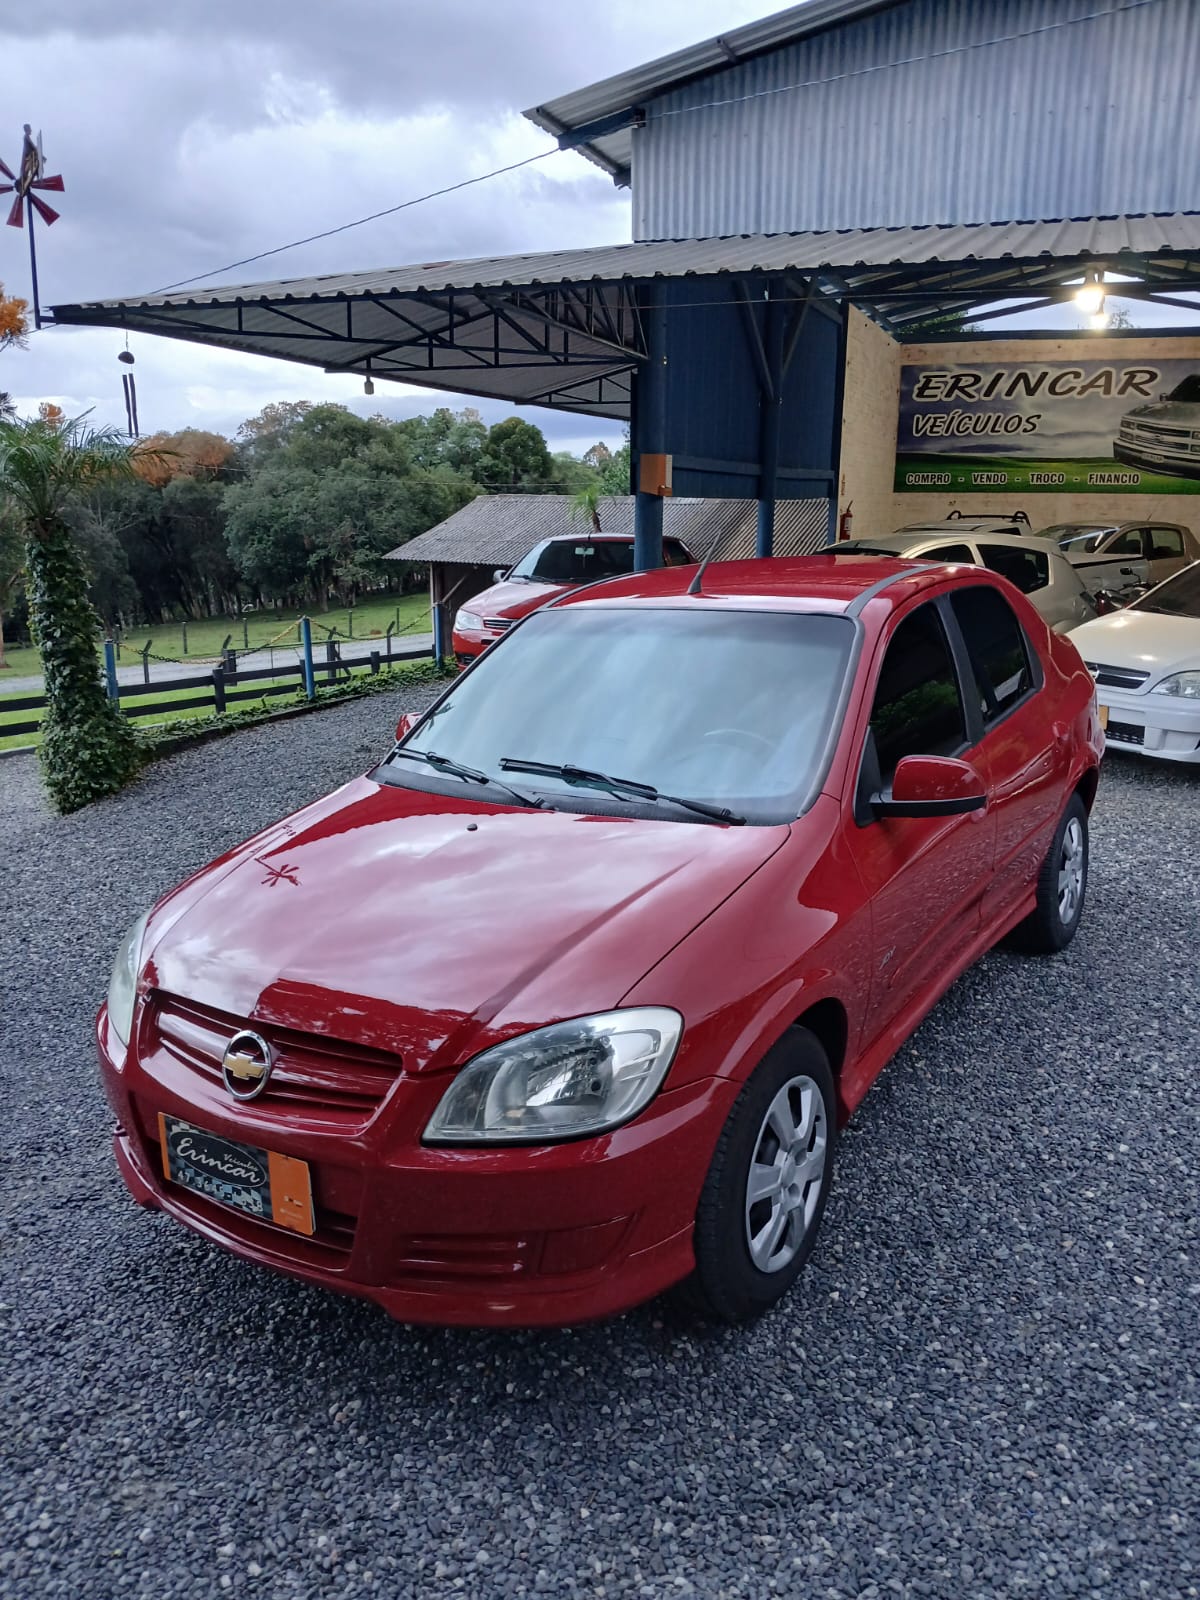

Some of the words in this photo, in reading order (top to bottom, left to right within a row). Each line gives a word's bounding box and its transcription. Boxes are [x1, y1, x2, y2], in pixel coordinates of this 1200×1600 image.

[914, 368, 1160, 400] ERINCAR
[914, 410, 1042, 436] VEÍCULOS
[905, 473, 950, 485] COMPRO
[972, 473, 1008, 484] VENDO
[1030, 472, 1065, 484] TROCO
[1088, 473, 1140, 484] FINANCIO
[176, 1137, 260, 1184] Erincar
